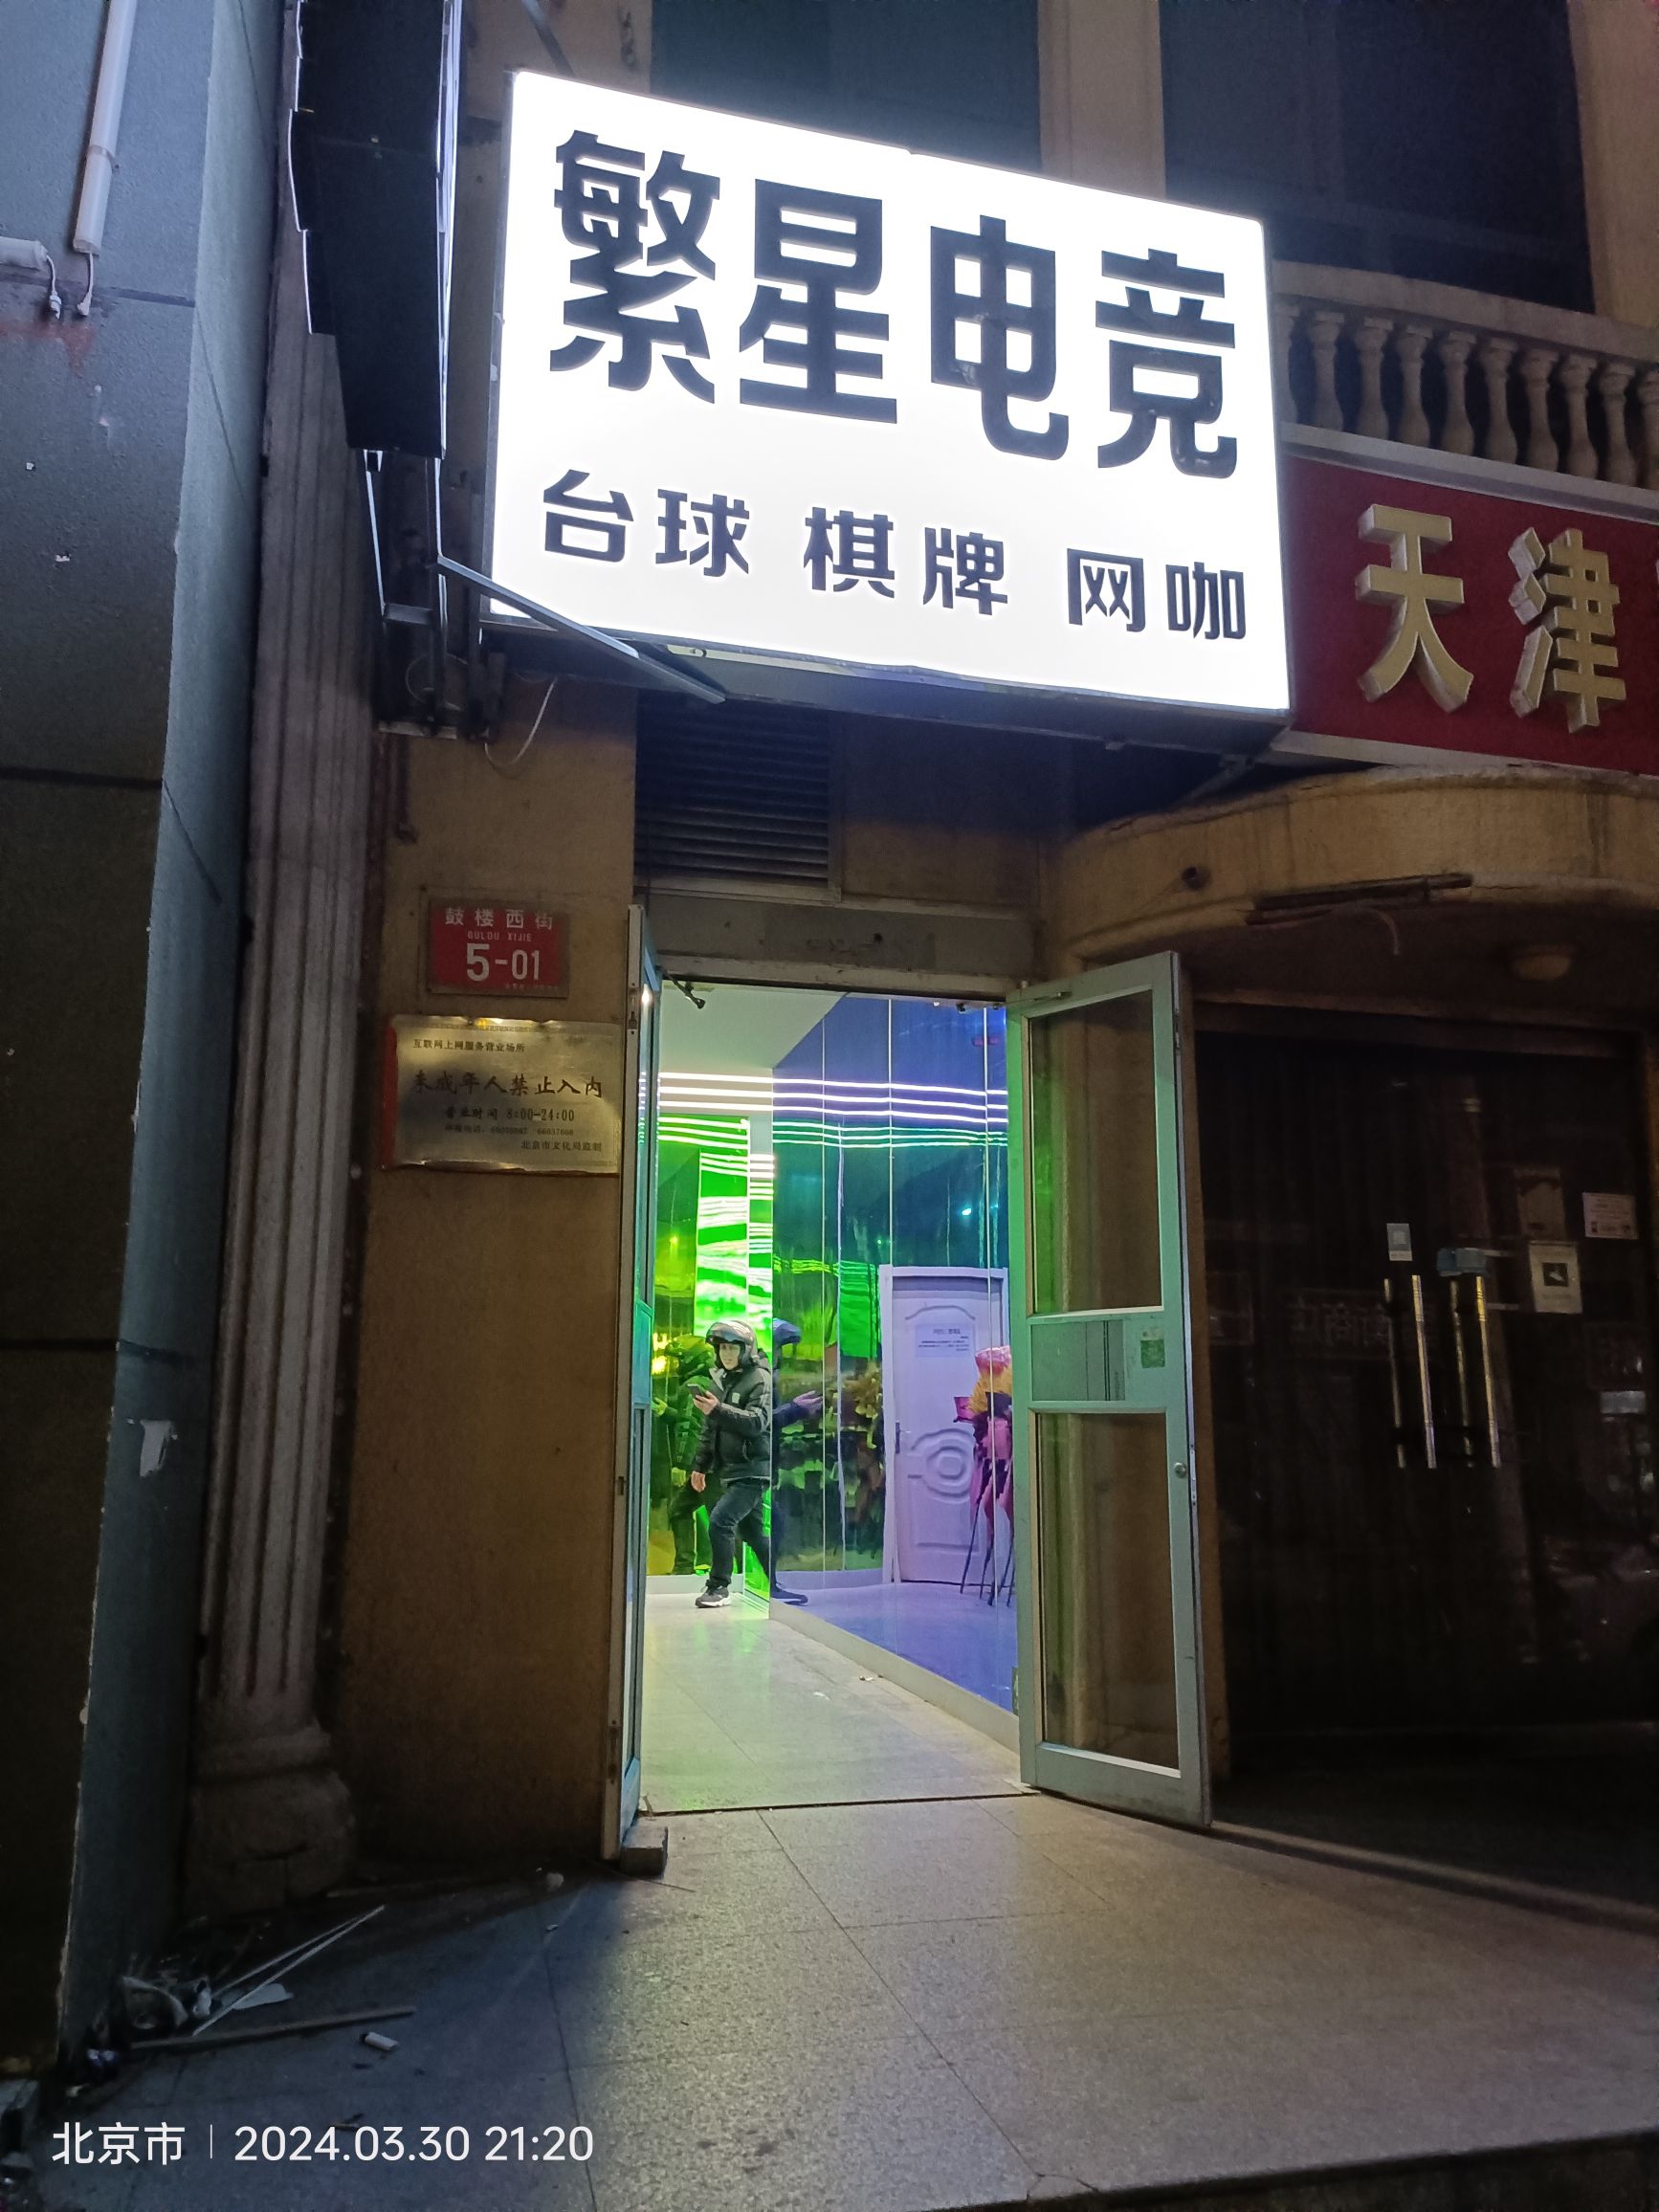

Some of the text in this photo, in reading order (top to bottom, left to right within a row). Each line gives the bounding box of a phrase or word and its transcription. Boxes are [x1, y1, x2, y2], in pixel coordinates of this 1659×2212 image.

[549, 129, 1237, 478] 繁星电竞
[542, 469, 1247, 640] 台球 棋牌 网咖
[445, 907, 552, 930] 鼓楼西街
[466, 942, 541, 982] 5-01
[413, 1038, 526, 1052] 互联网上网服务营业场所
[413, 1069, 603, 1098] 未成年人禁止入内
[445, 1104, 575, 1122] 营业时间 8:00-24:00
